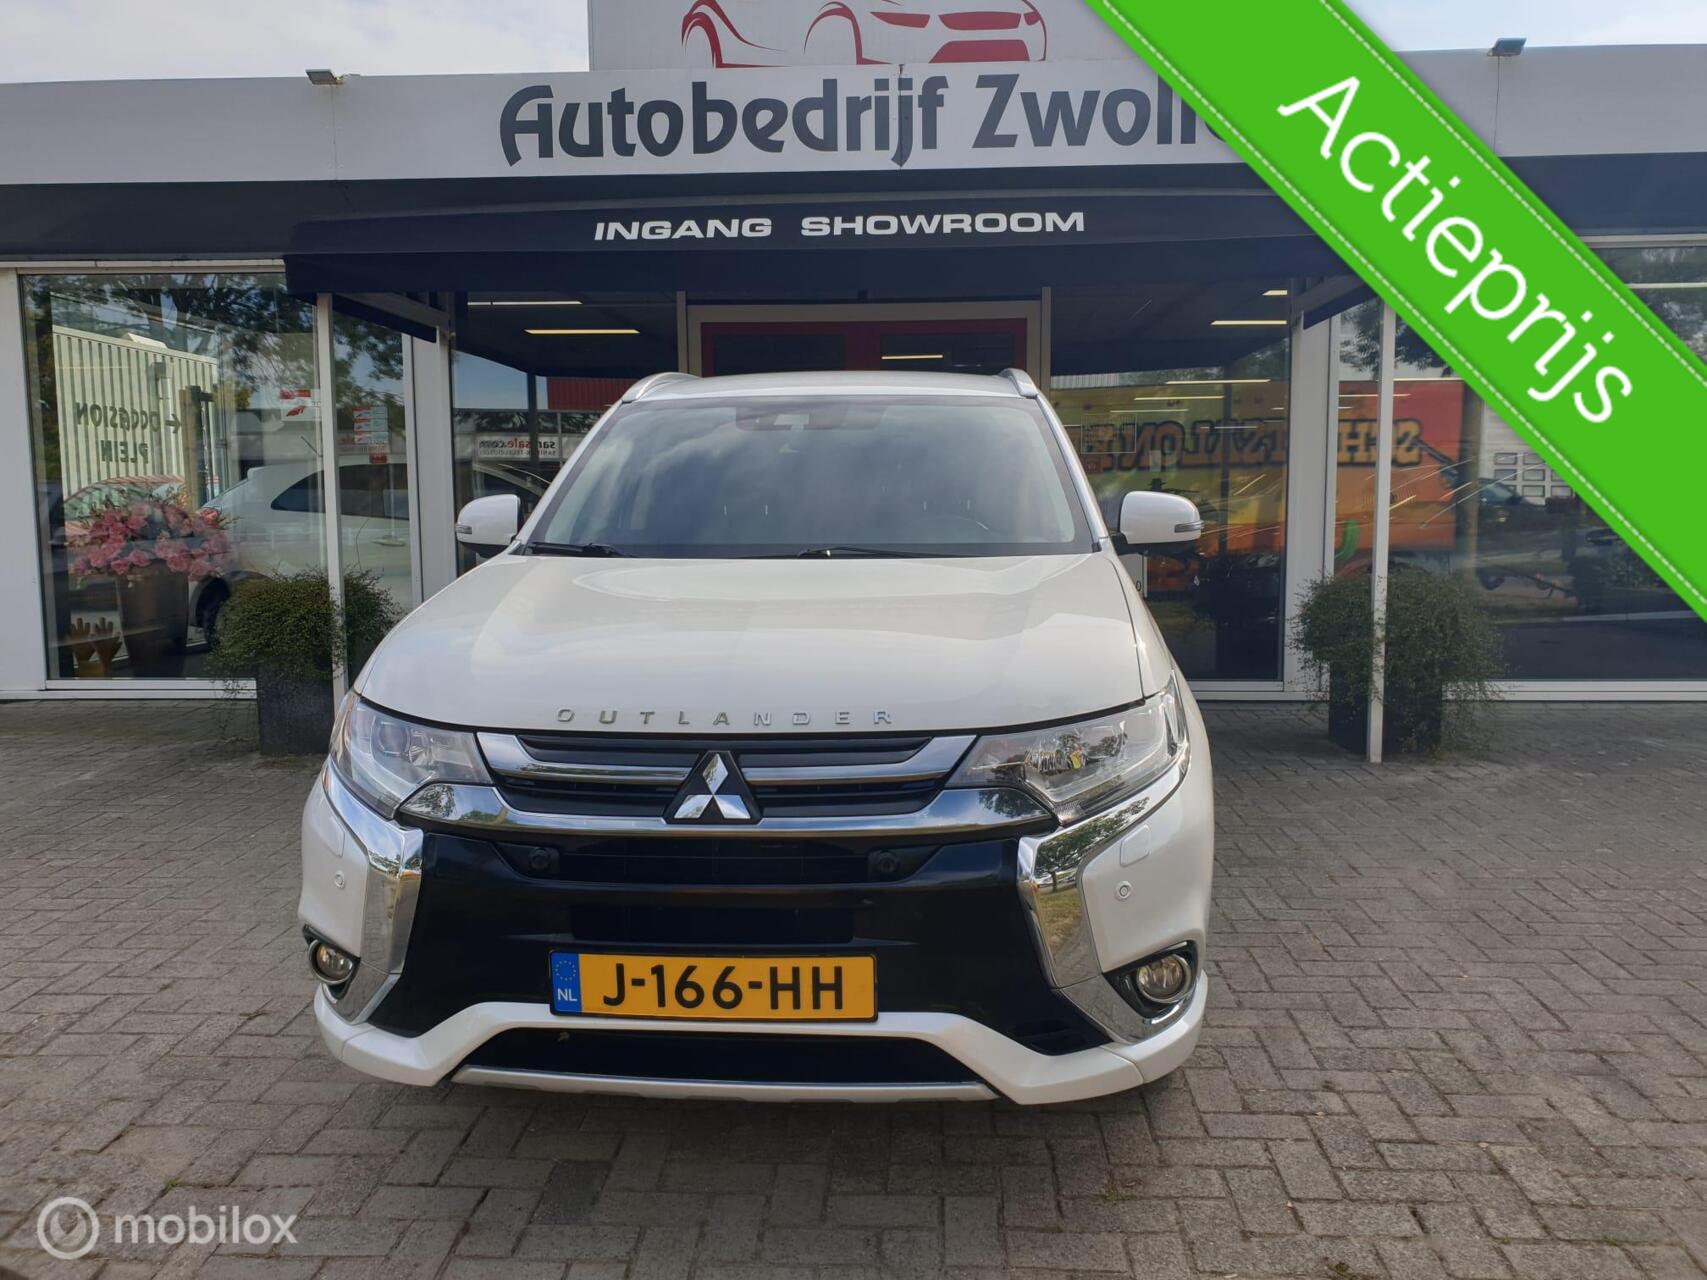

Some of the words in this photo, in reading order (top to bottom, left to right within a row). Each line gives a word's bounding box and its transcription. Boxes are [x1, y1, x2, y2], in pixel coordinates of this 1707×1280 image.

[500, 75, 950, 168] Autobedrijf
[972, 73, 1226, 148] Zwoll
[593, 217, 773, 241] INGANG
[800, 211, 1086, 237] SHOWROOM
[557, 707, 894, 727] OUTLANDER
[556, 987, 578, 1003] NL
[602, 962, 844, 1011] J-166-HH
